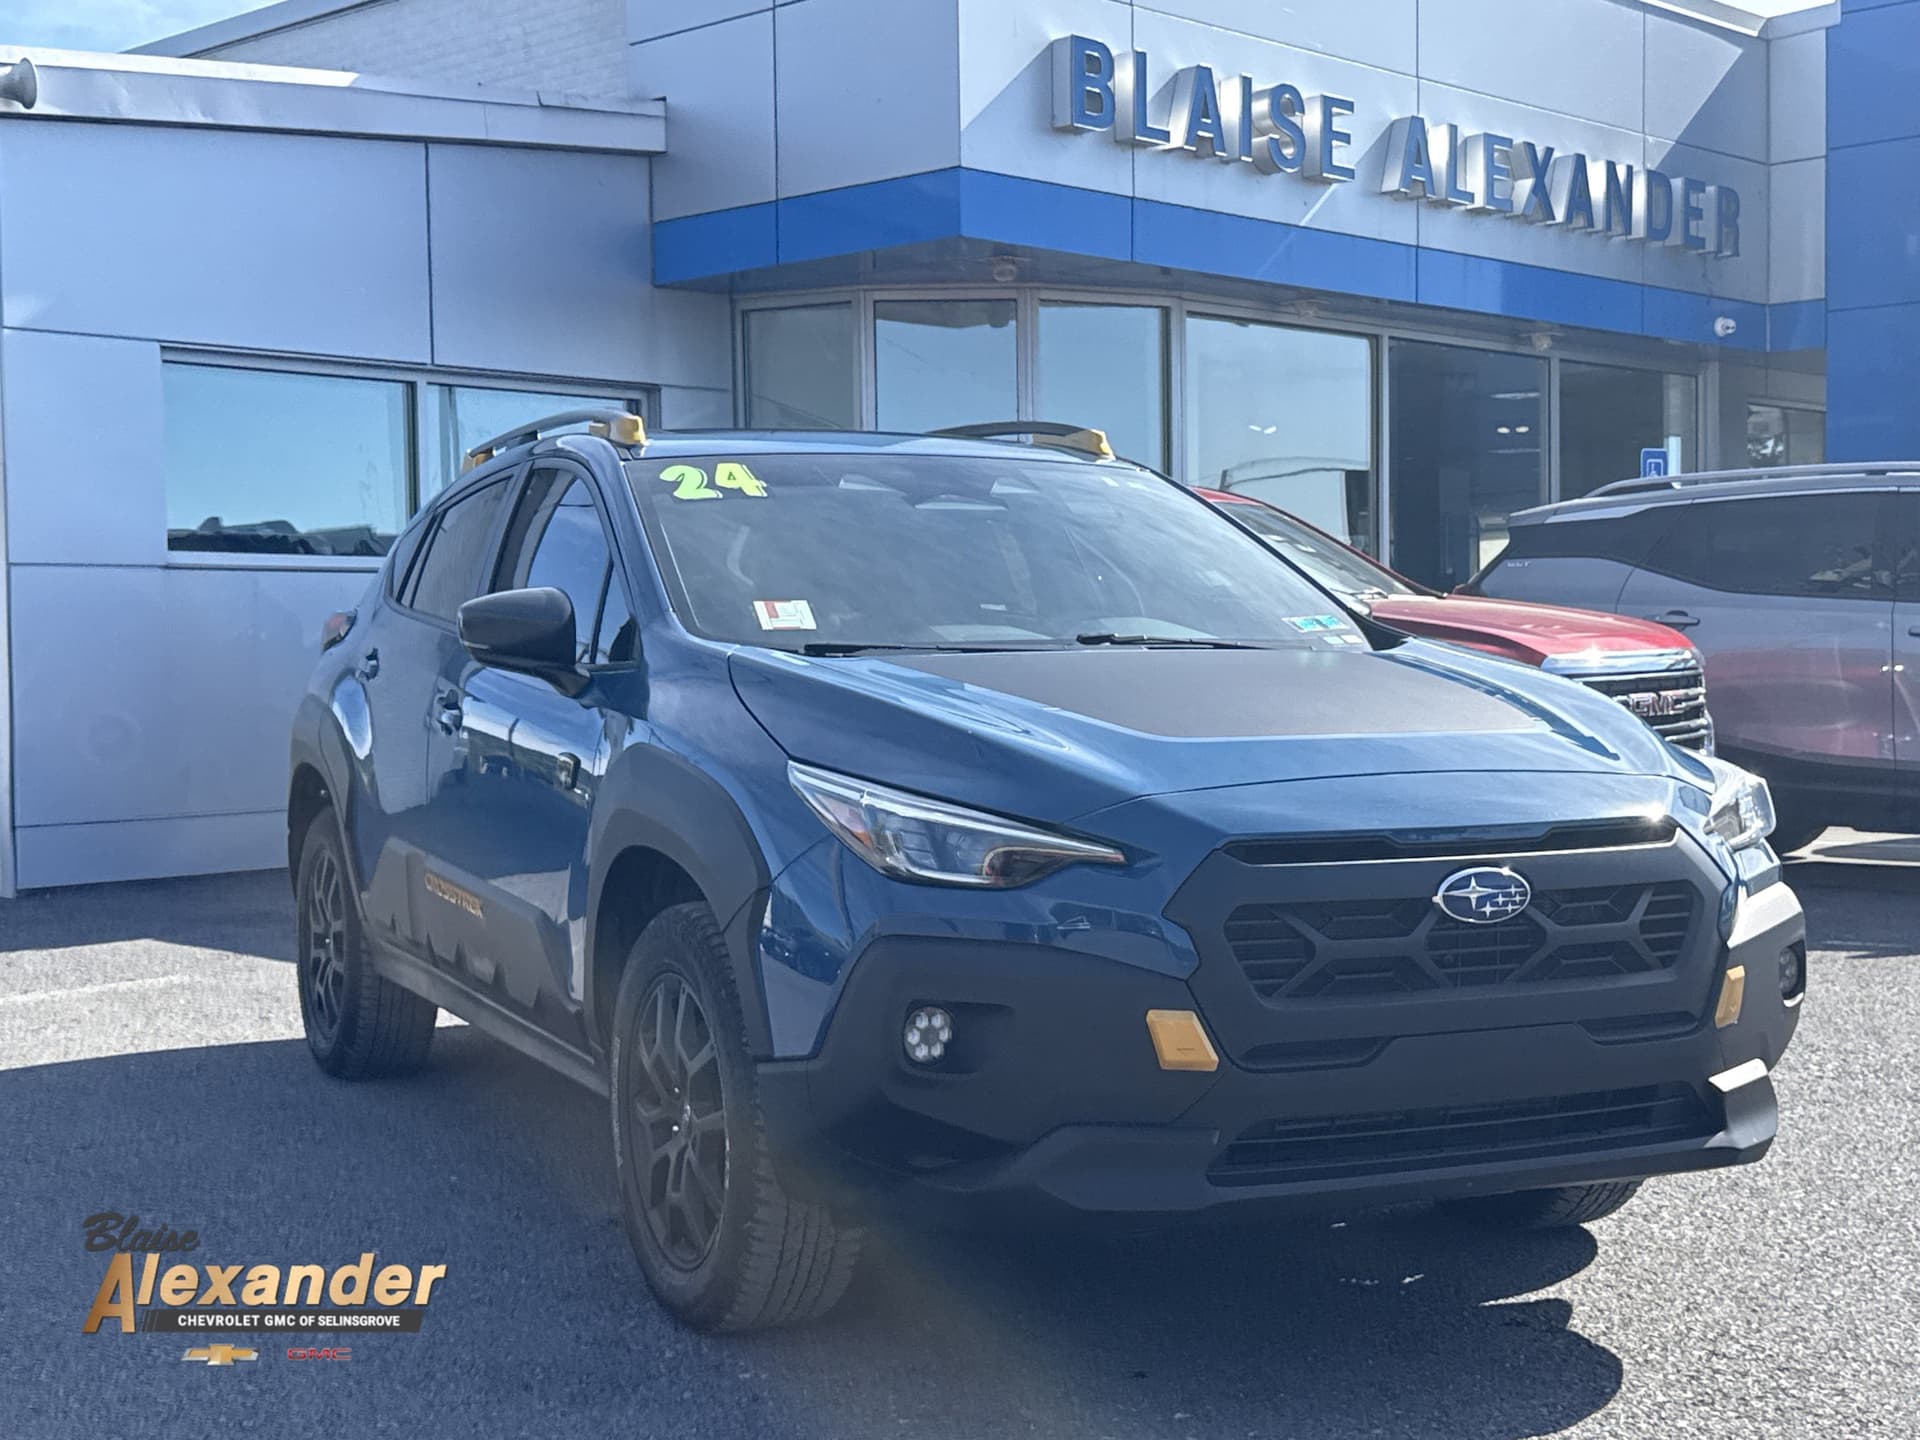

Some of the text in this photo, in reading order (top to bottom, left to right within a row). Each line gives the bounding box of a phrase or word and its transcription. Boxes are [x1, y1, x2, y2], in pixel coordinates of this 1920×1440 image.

[1067, 34, 1741, 258] BLAISE ALEXANDER
[659, 462, 768, 500] 24
[1629, 692, 1685, 717] GMC
